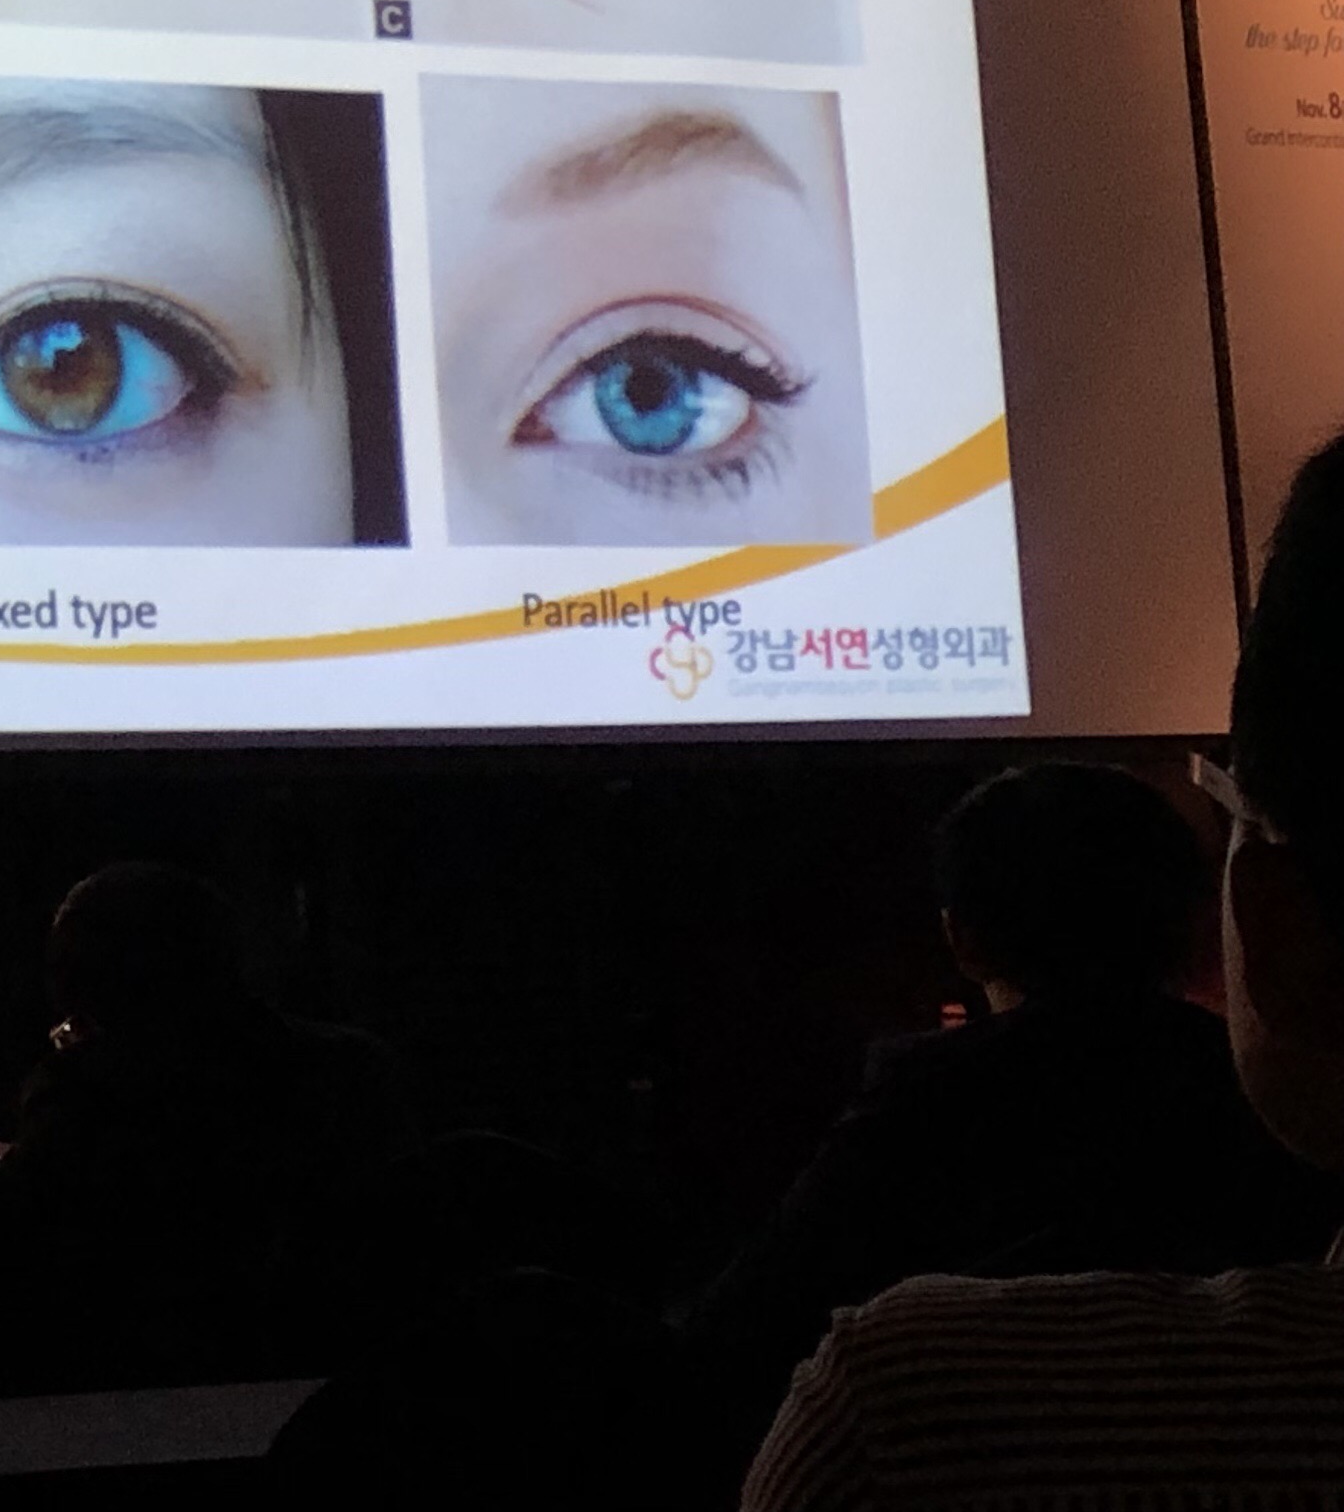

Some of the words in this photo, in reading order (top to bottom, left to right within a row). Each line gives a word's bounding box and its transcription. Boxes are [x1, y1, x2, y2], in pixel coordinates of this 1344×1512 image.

[381, 4, 405, 34] C
[67, 593, 159, 639] type
[523, 592, 651, 629] Parallel
[663, 593, 742, 634] type
[726, 625, 1012, 674] 강남서연성형외과
